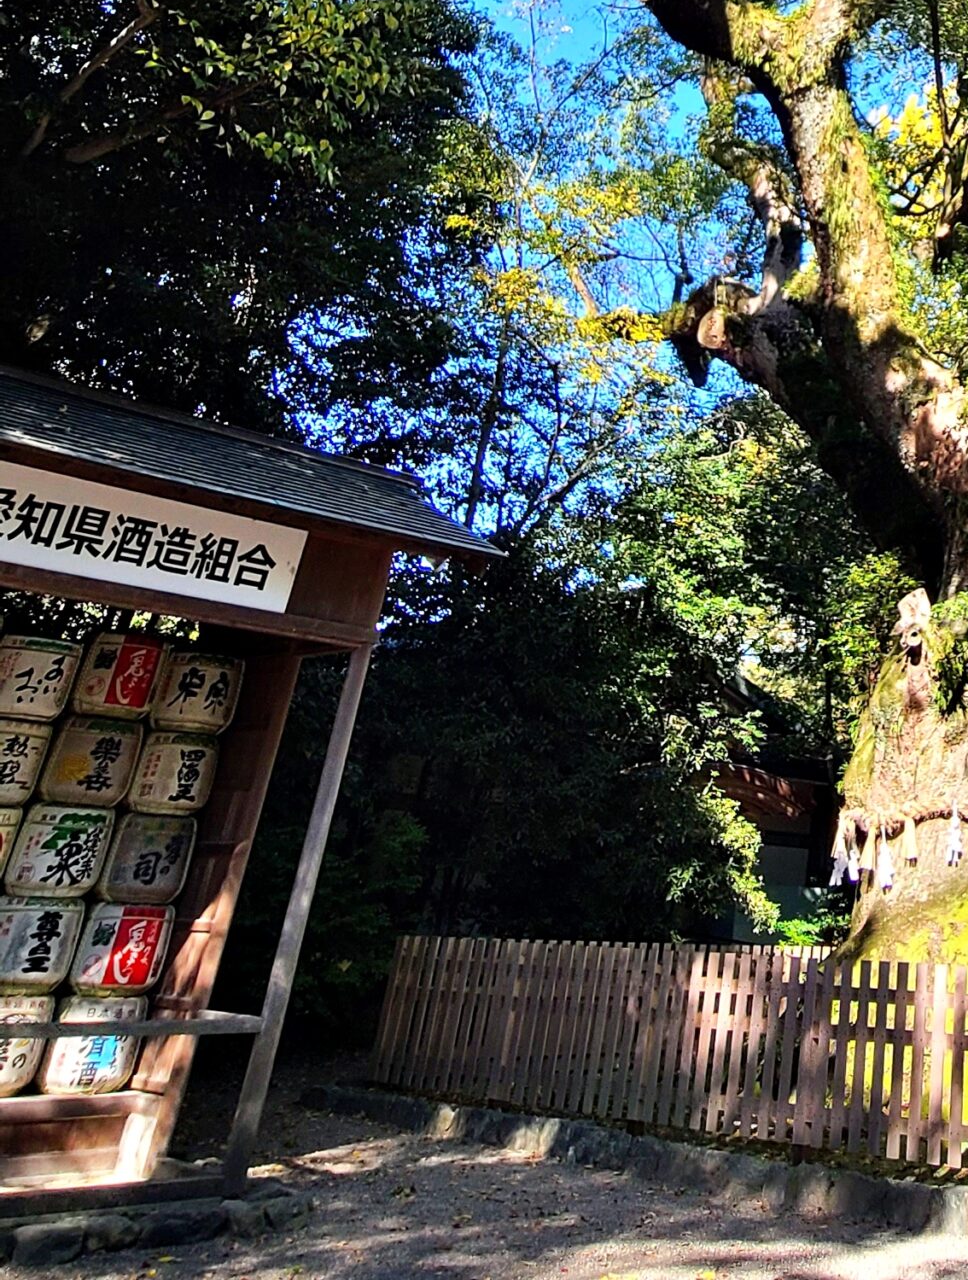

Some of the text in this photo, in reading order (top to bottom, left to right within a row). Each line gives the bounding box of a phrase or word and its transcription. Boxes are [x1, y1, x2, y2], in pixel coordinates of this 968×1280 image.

[168, 749, 206, 802] 四海王
[21, 911, 63, 973] 尊皇
